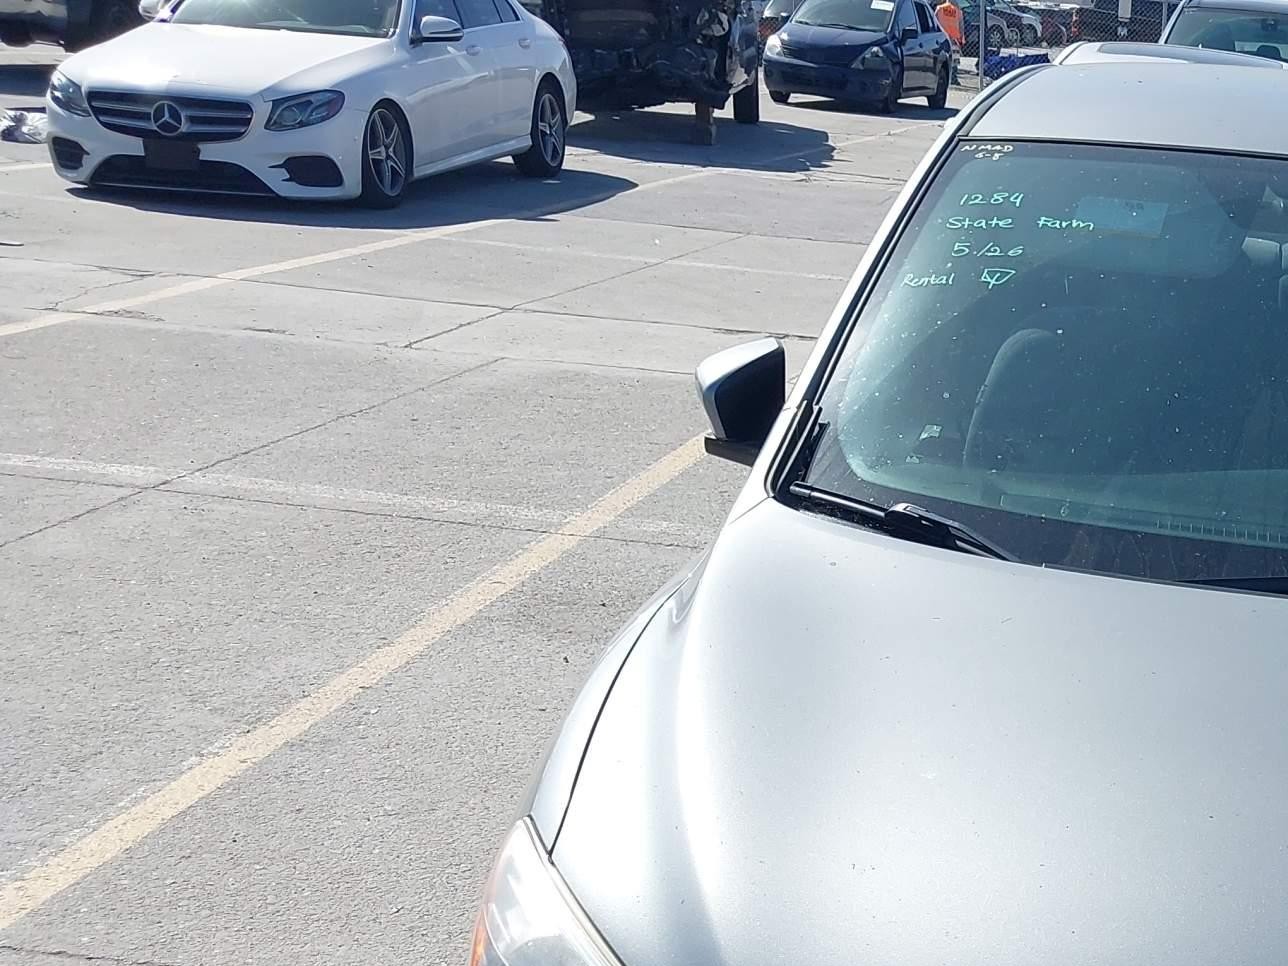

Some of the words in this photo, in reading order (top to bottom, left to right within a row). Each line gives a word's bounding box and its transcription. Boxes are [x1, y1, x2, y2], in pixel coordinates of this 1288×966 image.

[960, 192, 1024, 207] 1284
[946, 216, 1015, 229] State
[1037, 217, 1094, 231] Farm
[900, 273, 955, 287] Rental
